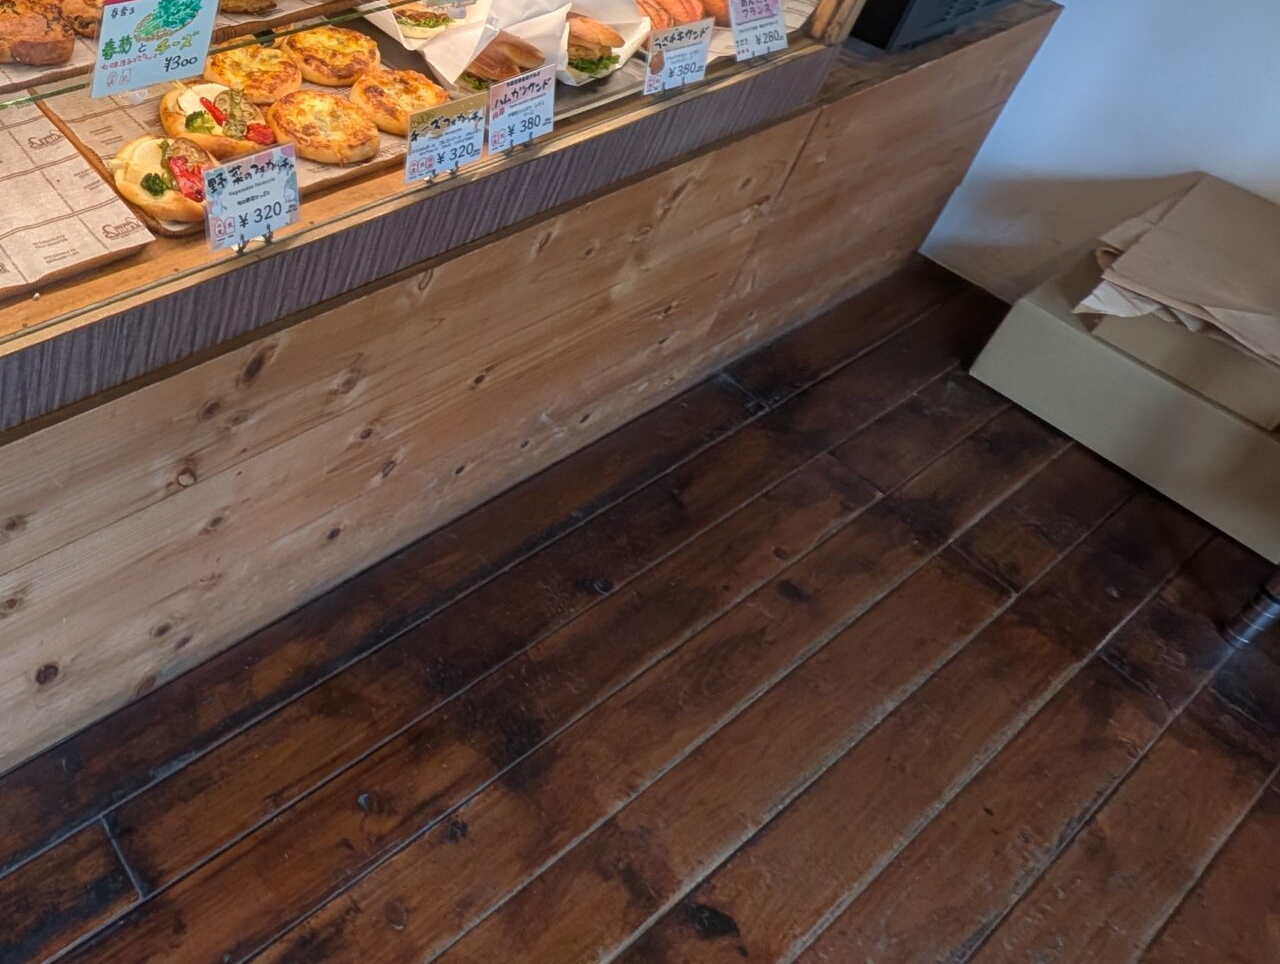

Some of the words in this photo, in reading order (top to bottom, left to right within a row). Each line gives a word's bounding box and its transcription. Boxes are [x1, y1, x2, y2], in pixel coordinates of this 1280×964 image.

[742, 4, 771, 18] フランス
[163, 55, 198, 73] ¥300
[668, 62, 697, 79] ¥380
[494, 77, 552, 109] ハムカツサンド
[410, 111, 483, 143] チーズフォカッチャ
[507, 114, 542, 138] ¥380
[437, 142, 475, 165] ¥320
[207, 157, 295, 194] 野菜のフォカッチャ
[238, 201, 282, 228] ¥320
